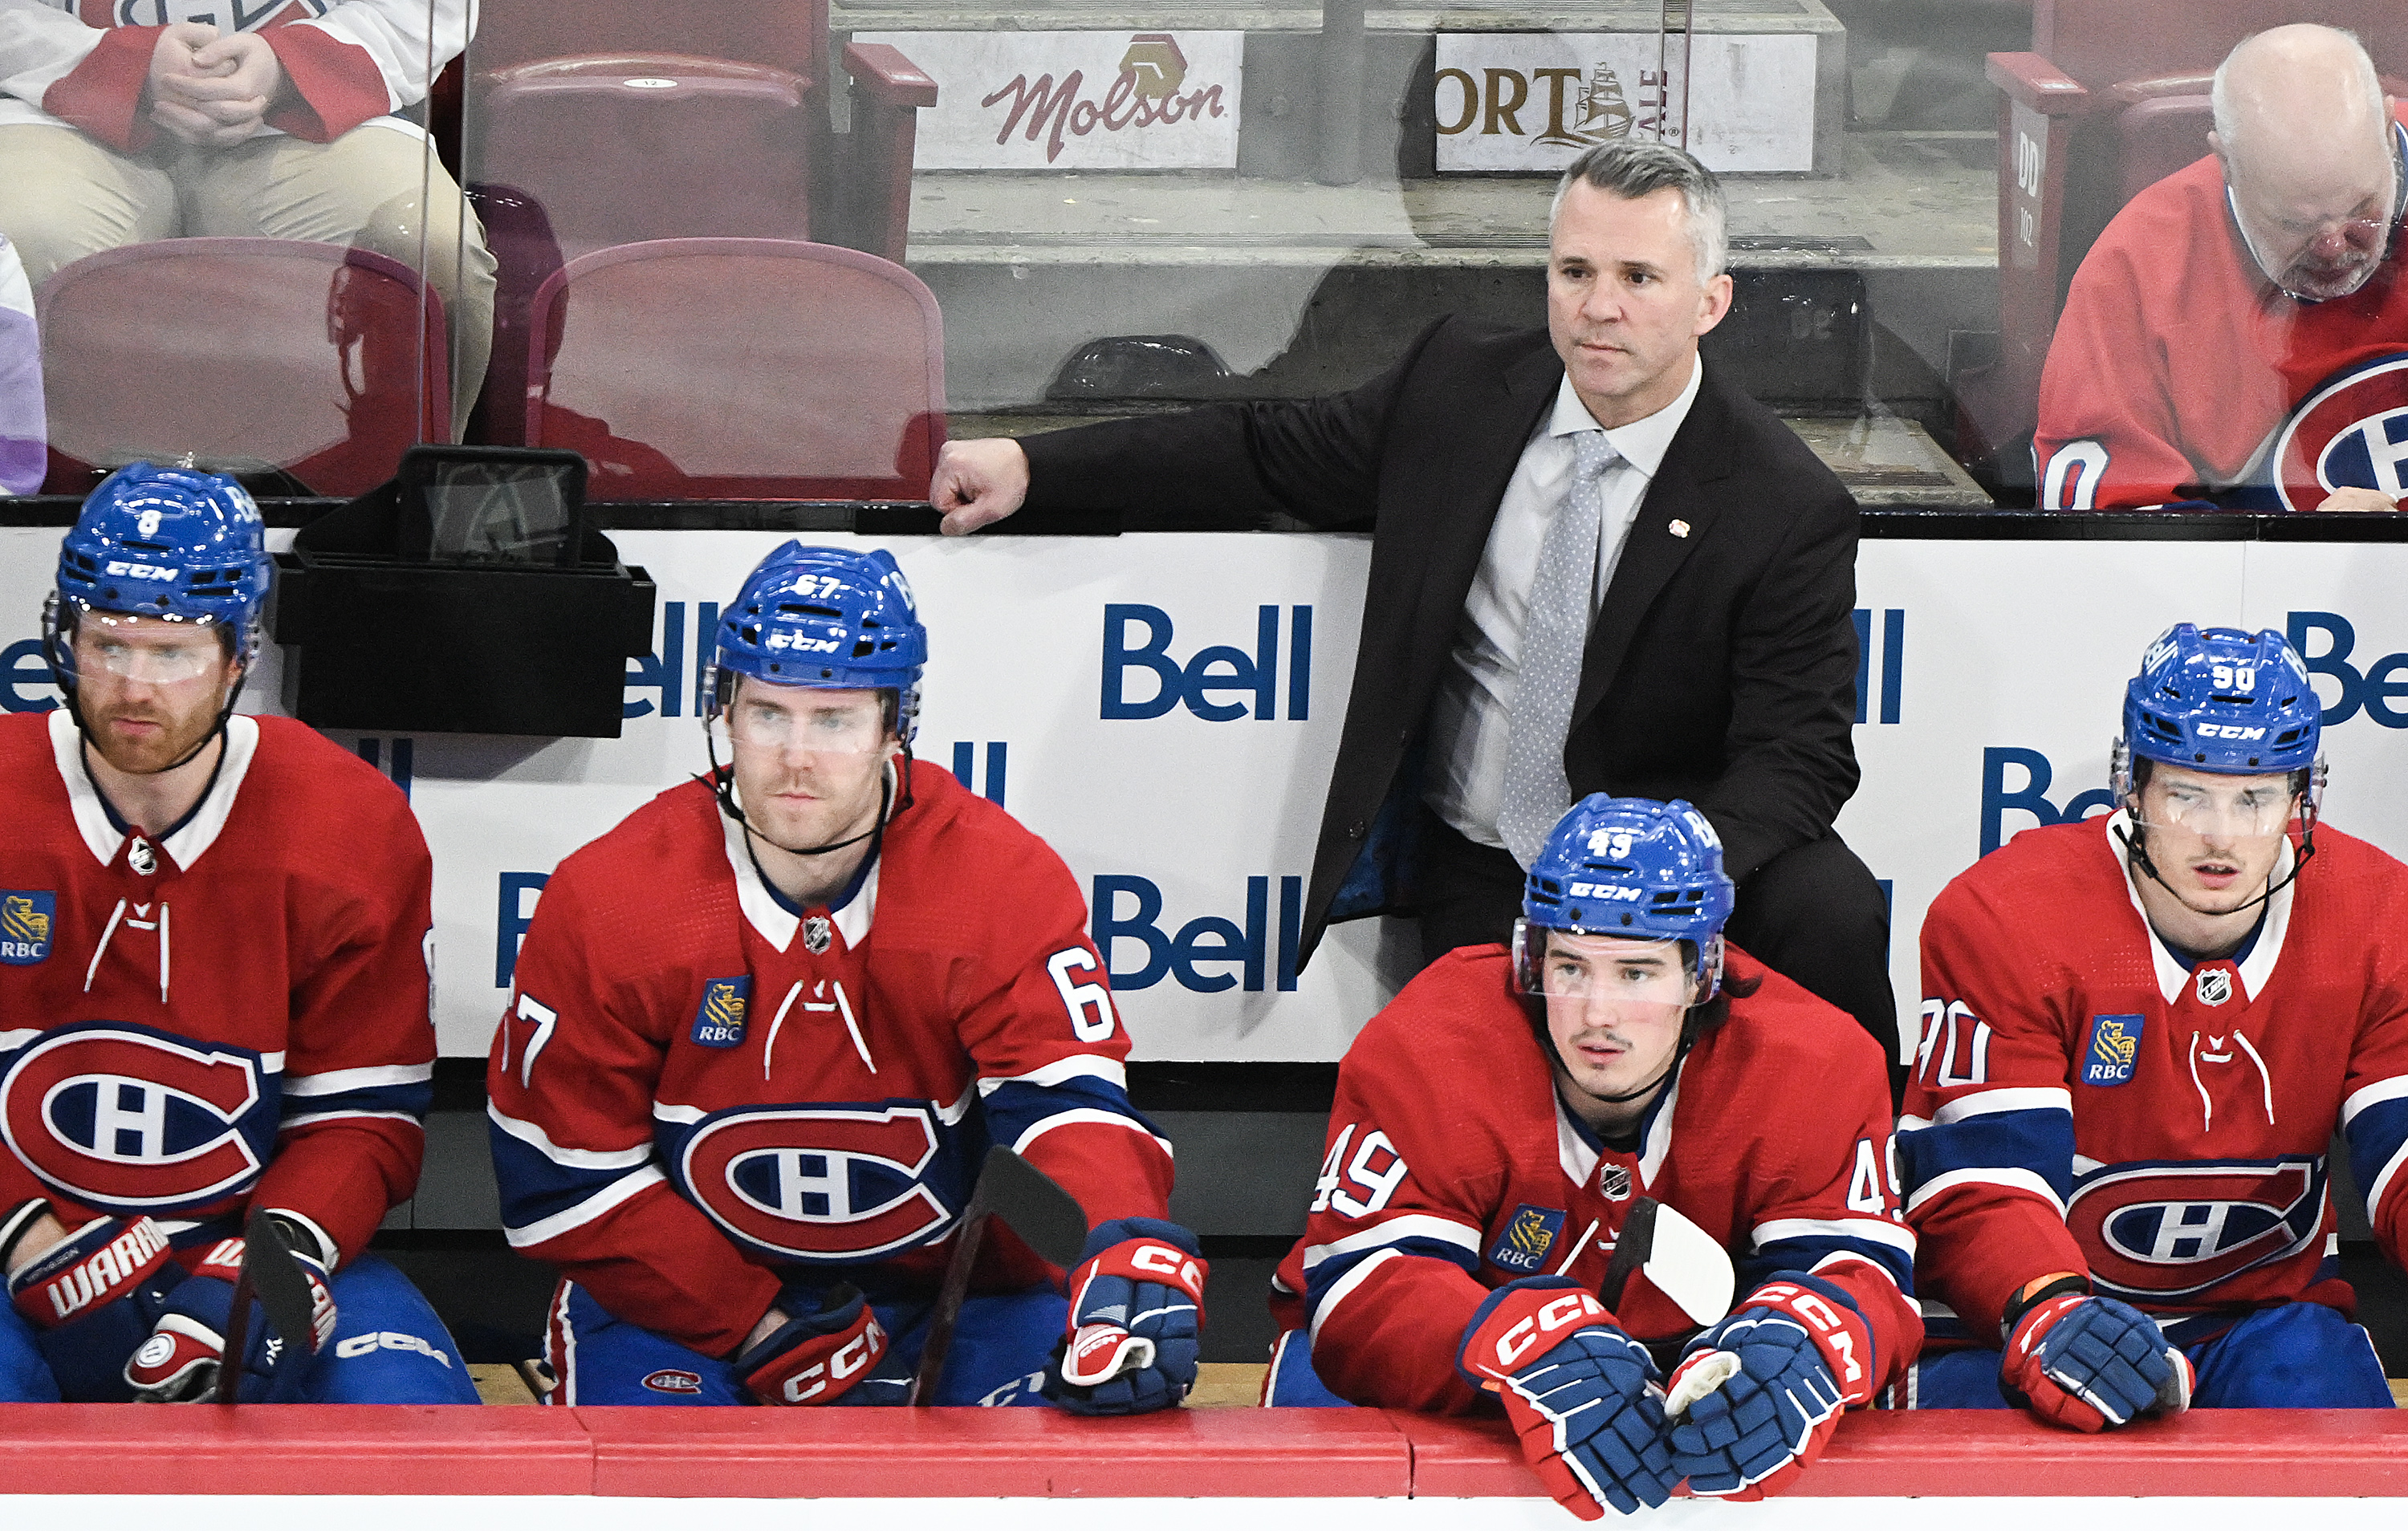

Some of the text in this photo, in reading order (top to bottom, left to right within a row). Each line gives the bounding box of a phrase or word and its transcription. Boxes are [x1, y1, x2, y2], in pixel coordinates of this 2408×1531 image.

[1435, 67, 1582, 136] ORT
[1638, 70, 1667, 136] ALE
[982, 70, 1224, 164] Molson
[2019, 132, 2039, 197] DD
[138, 510, 162, 535] 8
[106, 561, 179, 582] CCM
[1100, 603, 1312, 722] Bell
[2213, 665, 2255, 692] 90
[2197, 722, 2266, 741] CCM
[1588, 828, 1633, 859] 49
[1569, 882, 1642, 902] CCM
[1090, 875, 1302, 993] Bell
[1, 940, 46, 958] RBC
[698, 1026, 741, 1042] RBC
[2089, 1064, 2129, 1080] RBC
[1310, 1123, 1409, 1219] 49
[1496, 1247, 1540, 1269] RBC
[1745, 1285, 1862, 1383] CCM
